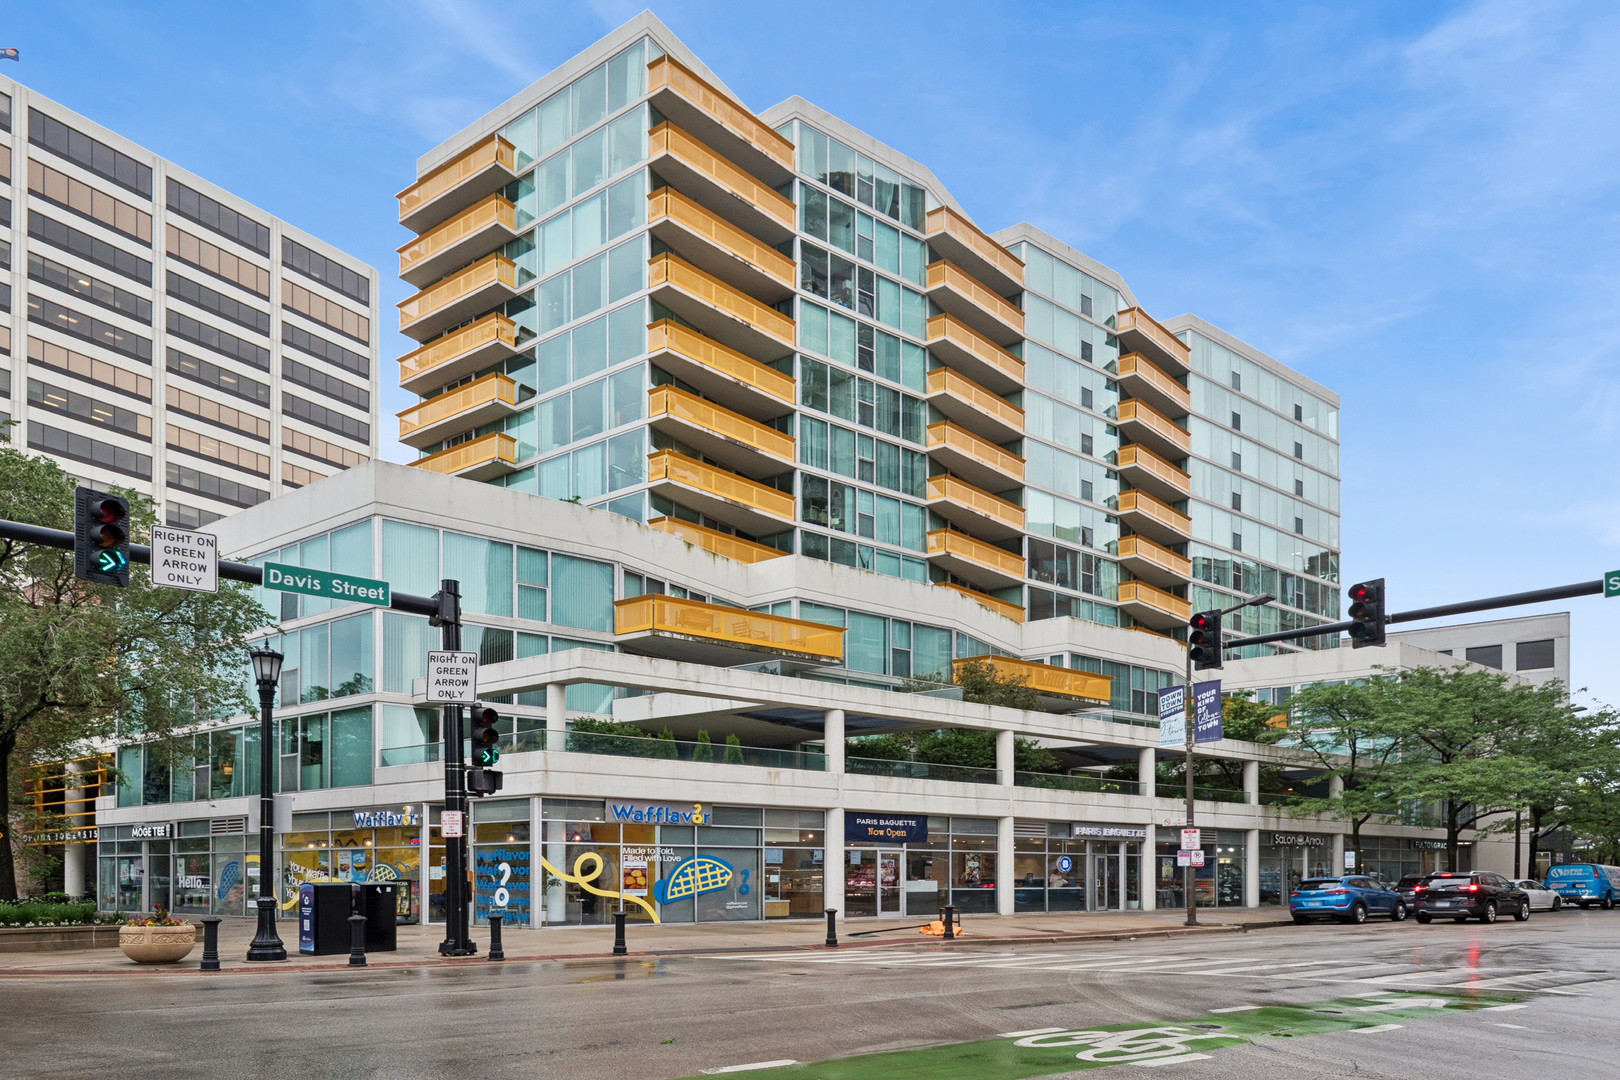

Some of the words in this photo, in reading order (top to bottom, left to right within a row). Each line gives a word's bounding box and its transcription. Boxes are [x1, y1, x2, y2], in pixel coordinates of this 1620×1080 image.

[154, 530, 192, 544] RIGHT
[197, 537, 214, 548] ON
[164, 545, 205, 559] GREEN
[162, 559, 207, 573] ARROW
[167, 572, 202, 585] ONLY
[269, 569, 321, 590] Davis
[331, 579, 384, 600] Street
[429, 655, 458, 663] RIGHT
[461, 656, 475, 664] ON
[436, 666, 468, 676] GREEN
[434, 678, 469, 687] ARROW
[438, 689, 464, 699] ONLY
[1161, 691, 1182, 703] DOWN
[1197, 689, 1216, 700] YOUR
[1161, 697, 1182, 710] TOWN
[1197, 697, 1215, 707] KIND
[1197, 705, 1206, 714] OF
[1198, 720, 1219, 732] TOWN
[879, 819, 917, 827] BAGUETTE
[152, 826, 165, 836] TEE
[867, 827, 884, 836] Now
[886, 828, 907, 839] Open
[1075, 826, 1101, 836] PARIS
[1102, 827, 1146, 838] BAGUETTE
[475, 848, 530, 861] Wafflavor
[178, 875, 205, 889] Hello.
